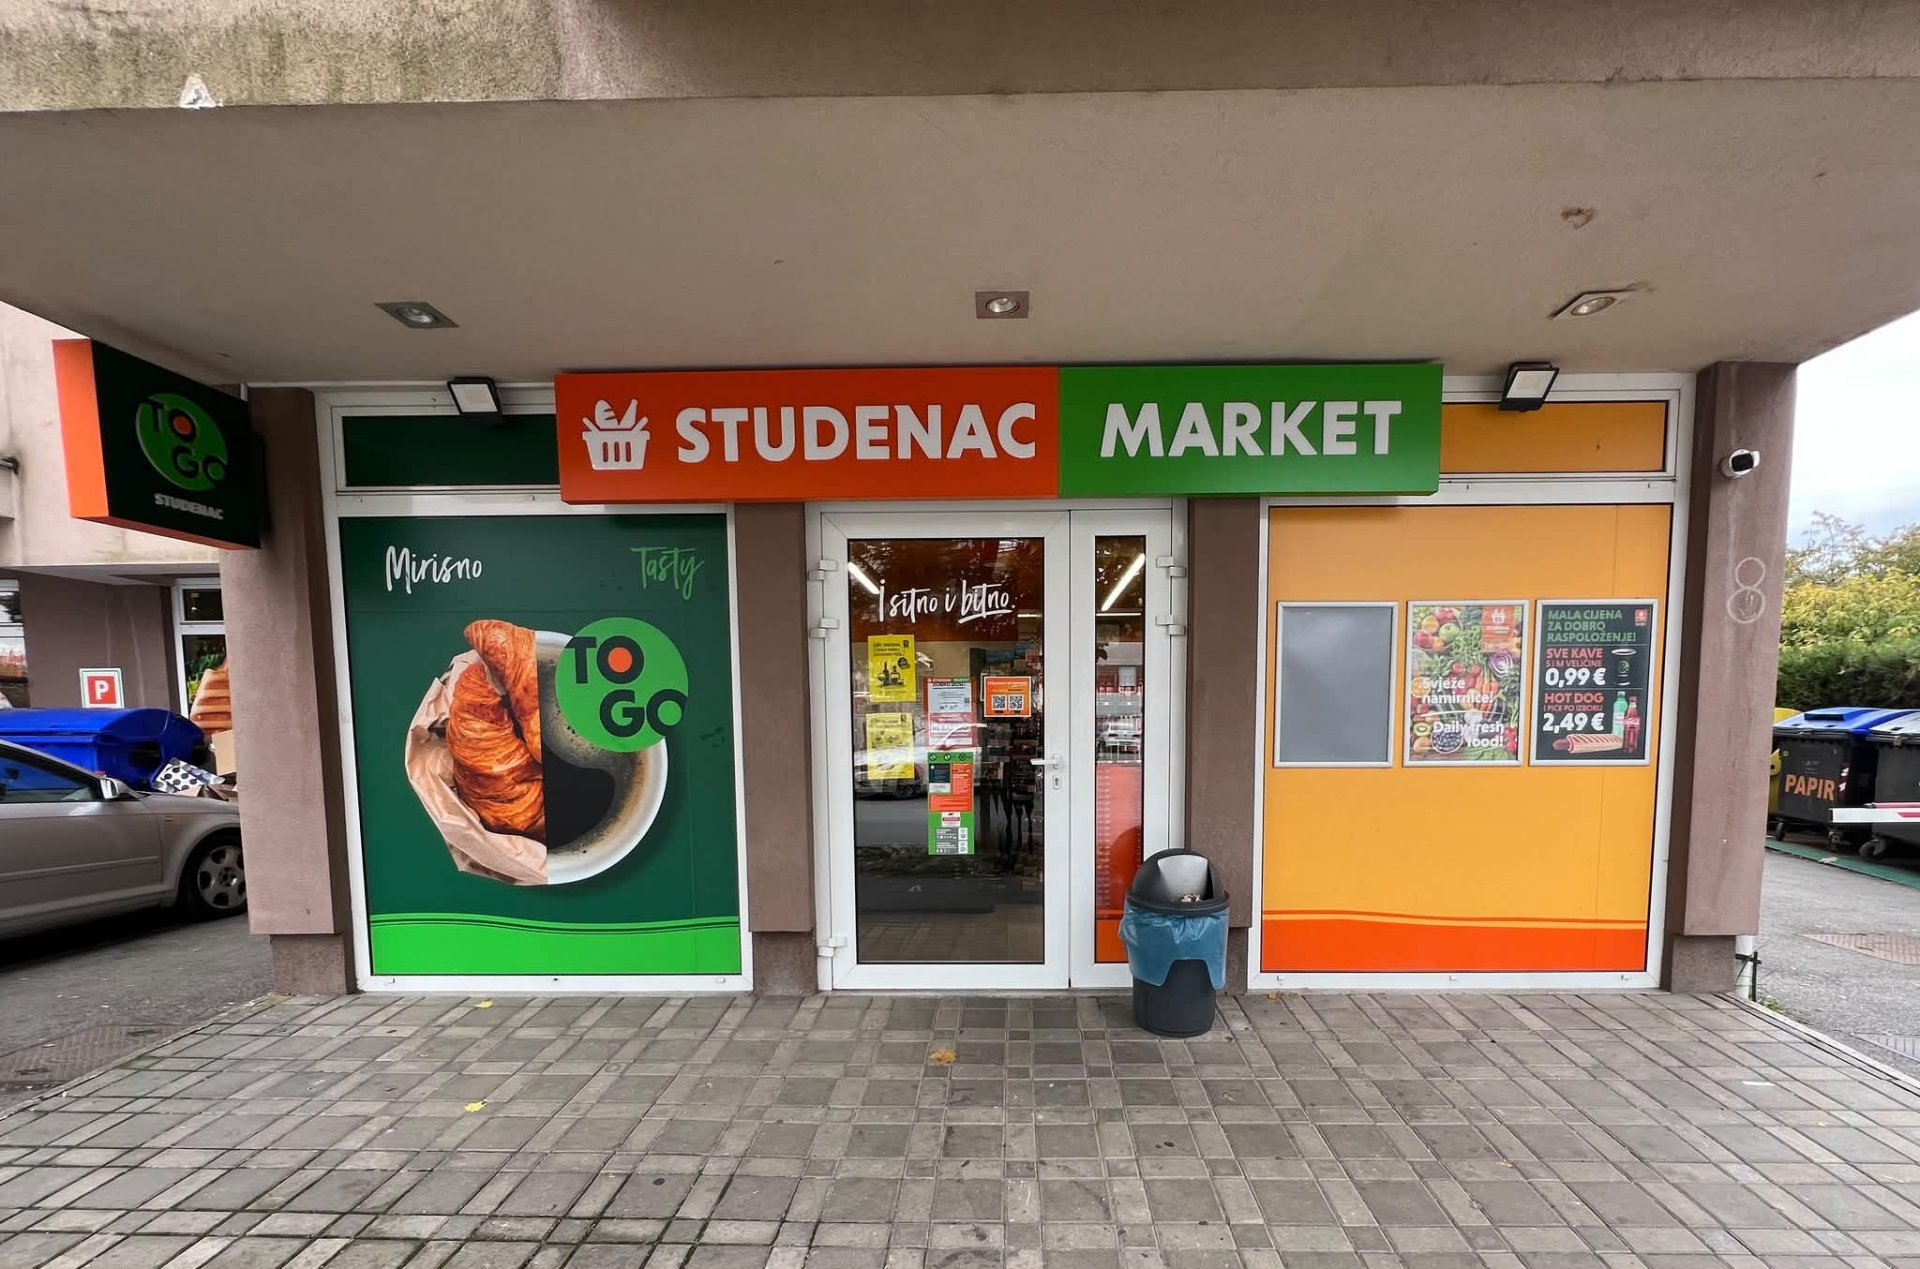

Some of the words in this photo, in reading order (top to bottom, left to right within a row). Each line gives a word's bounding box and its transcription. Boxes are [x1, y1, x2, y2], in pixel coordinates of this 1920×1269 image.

[138, 398, 199, 443] TO
[676, 403, 1035, 463] STUDENAC
[1100, 401, 1402, 457] MARKET
[171, 445, 227, 487] GO
[154, 493, 223, 520] STUDENAC
[385, 545, 482, 594] Mirisno
[630, 547, 705, 599] Tasty
[889, 588, 938, 623] sitno
[945, 587, 956, 612] i
[1547, 609, 1582, 620] MALA
[1583, 609, 1622, 620] CIJENA
[1547, 621, 1562, 631] ZA
[1564, 621, 1606, 631] DOBRO
[1547, 631, 1636, 642] RASPOLOŽENJE!
[564, 635, 645, 684] TO
[1546, 648, 1569, 659] SVE
[1571, 647, 1604, 659] KAVE
[1422, 677, 1466, 691] Svježe
[1545, 667, 1590, 688] 0,99
[1592, 667, 1606, 686] €
[95, 680, 109, 700] P
[1422, 691, 1494, 704] namirnice!
[1544, 693, 1572, 704] HOT
[1574, 693, 1605, 704] DOG
[599, 688, 689, 738] GO
[1543, 713, 1588, 734] 2,49
[1591, 713, 1605, 731] €
[1433, 721, 1467, 736] Daily
[1785, 774, 1836, 801] PAPIR
